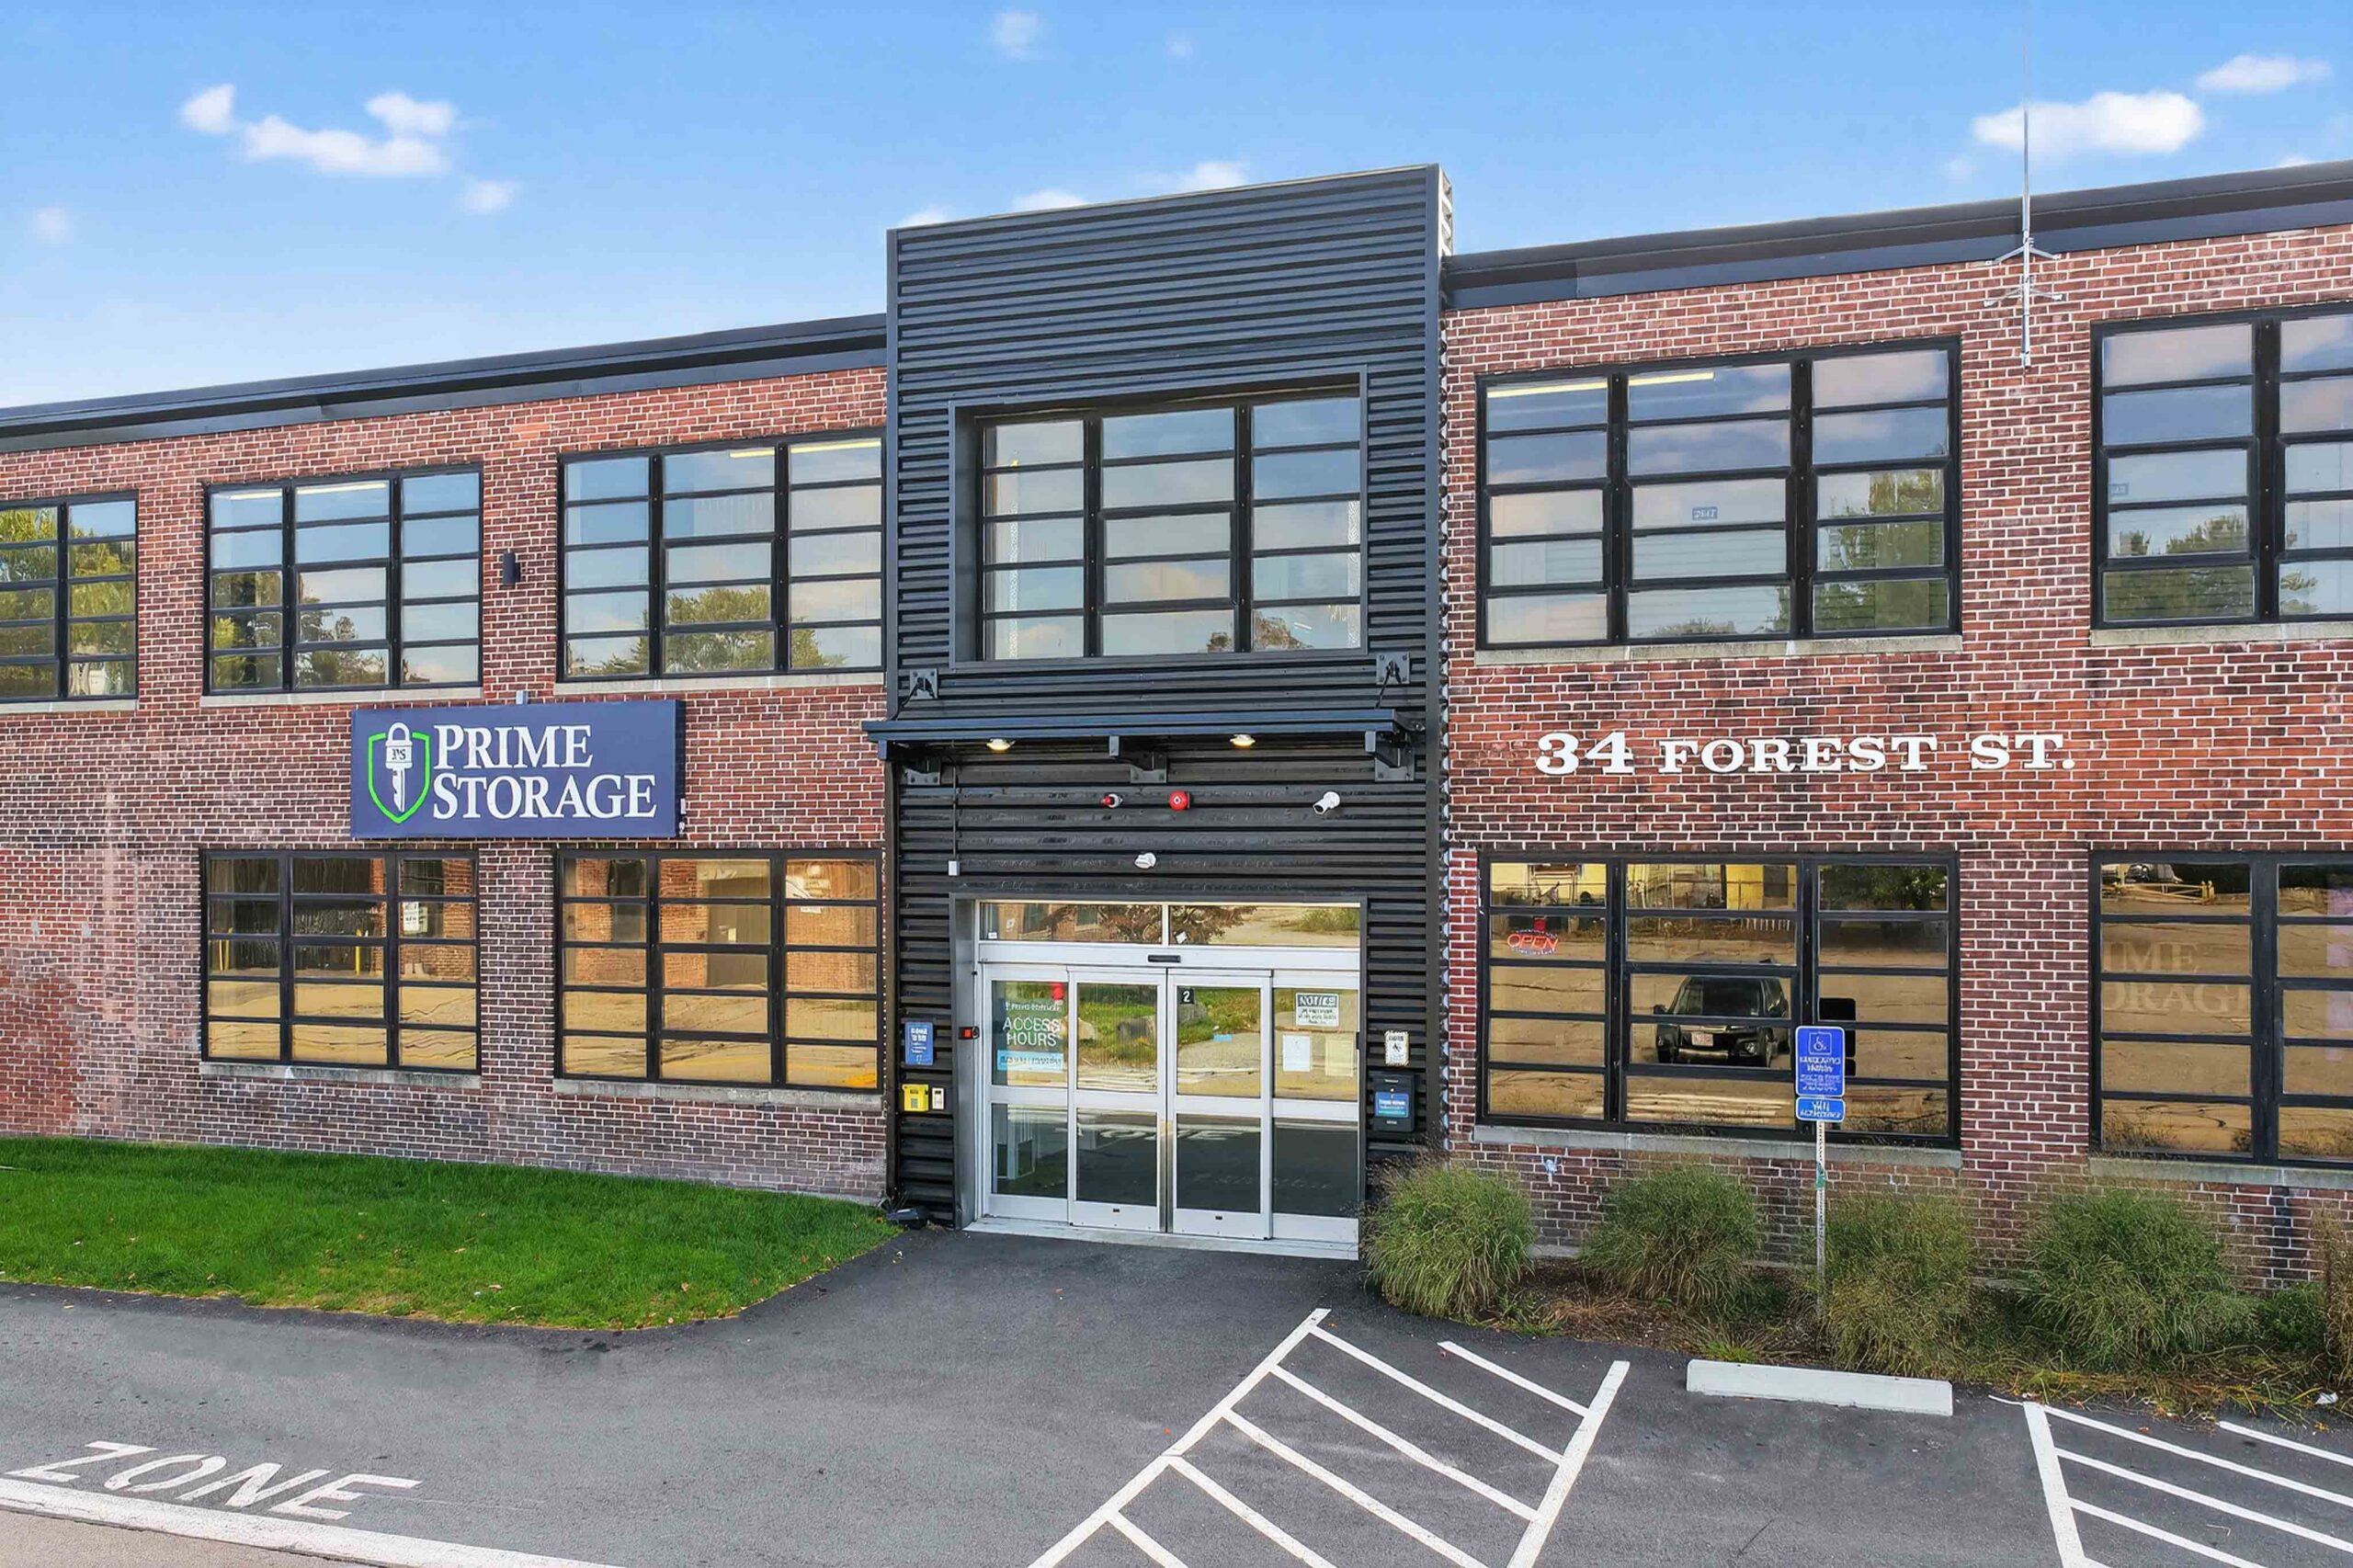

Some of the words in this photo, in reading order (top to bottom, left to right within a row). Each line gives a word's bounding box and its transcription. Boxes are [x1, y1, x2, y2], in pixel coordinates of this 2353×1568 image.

[432, 724, 594, 769] PRIME
[1535, 732, 1635, 775] 34
[1658, 735, 1938, 774] FOREST
[1971, 734, 2076, 770] ST.
[432, 772, 657, 819] STORAGE
[1507, 933, 1559, 952] OPEN
[1183, 990, 1191, 1003] 2
[1002, 1017, 1061, 1032] ACCESS
[1006, 1031, 1057, 1047] HOURS
[5, 1440, 423, 1521] ZONE
